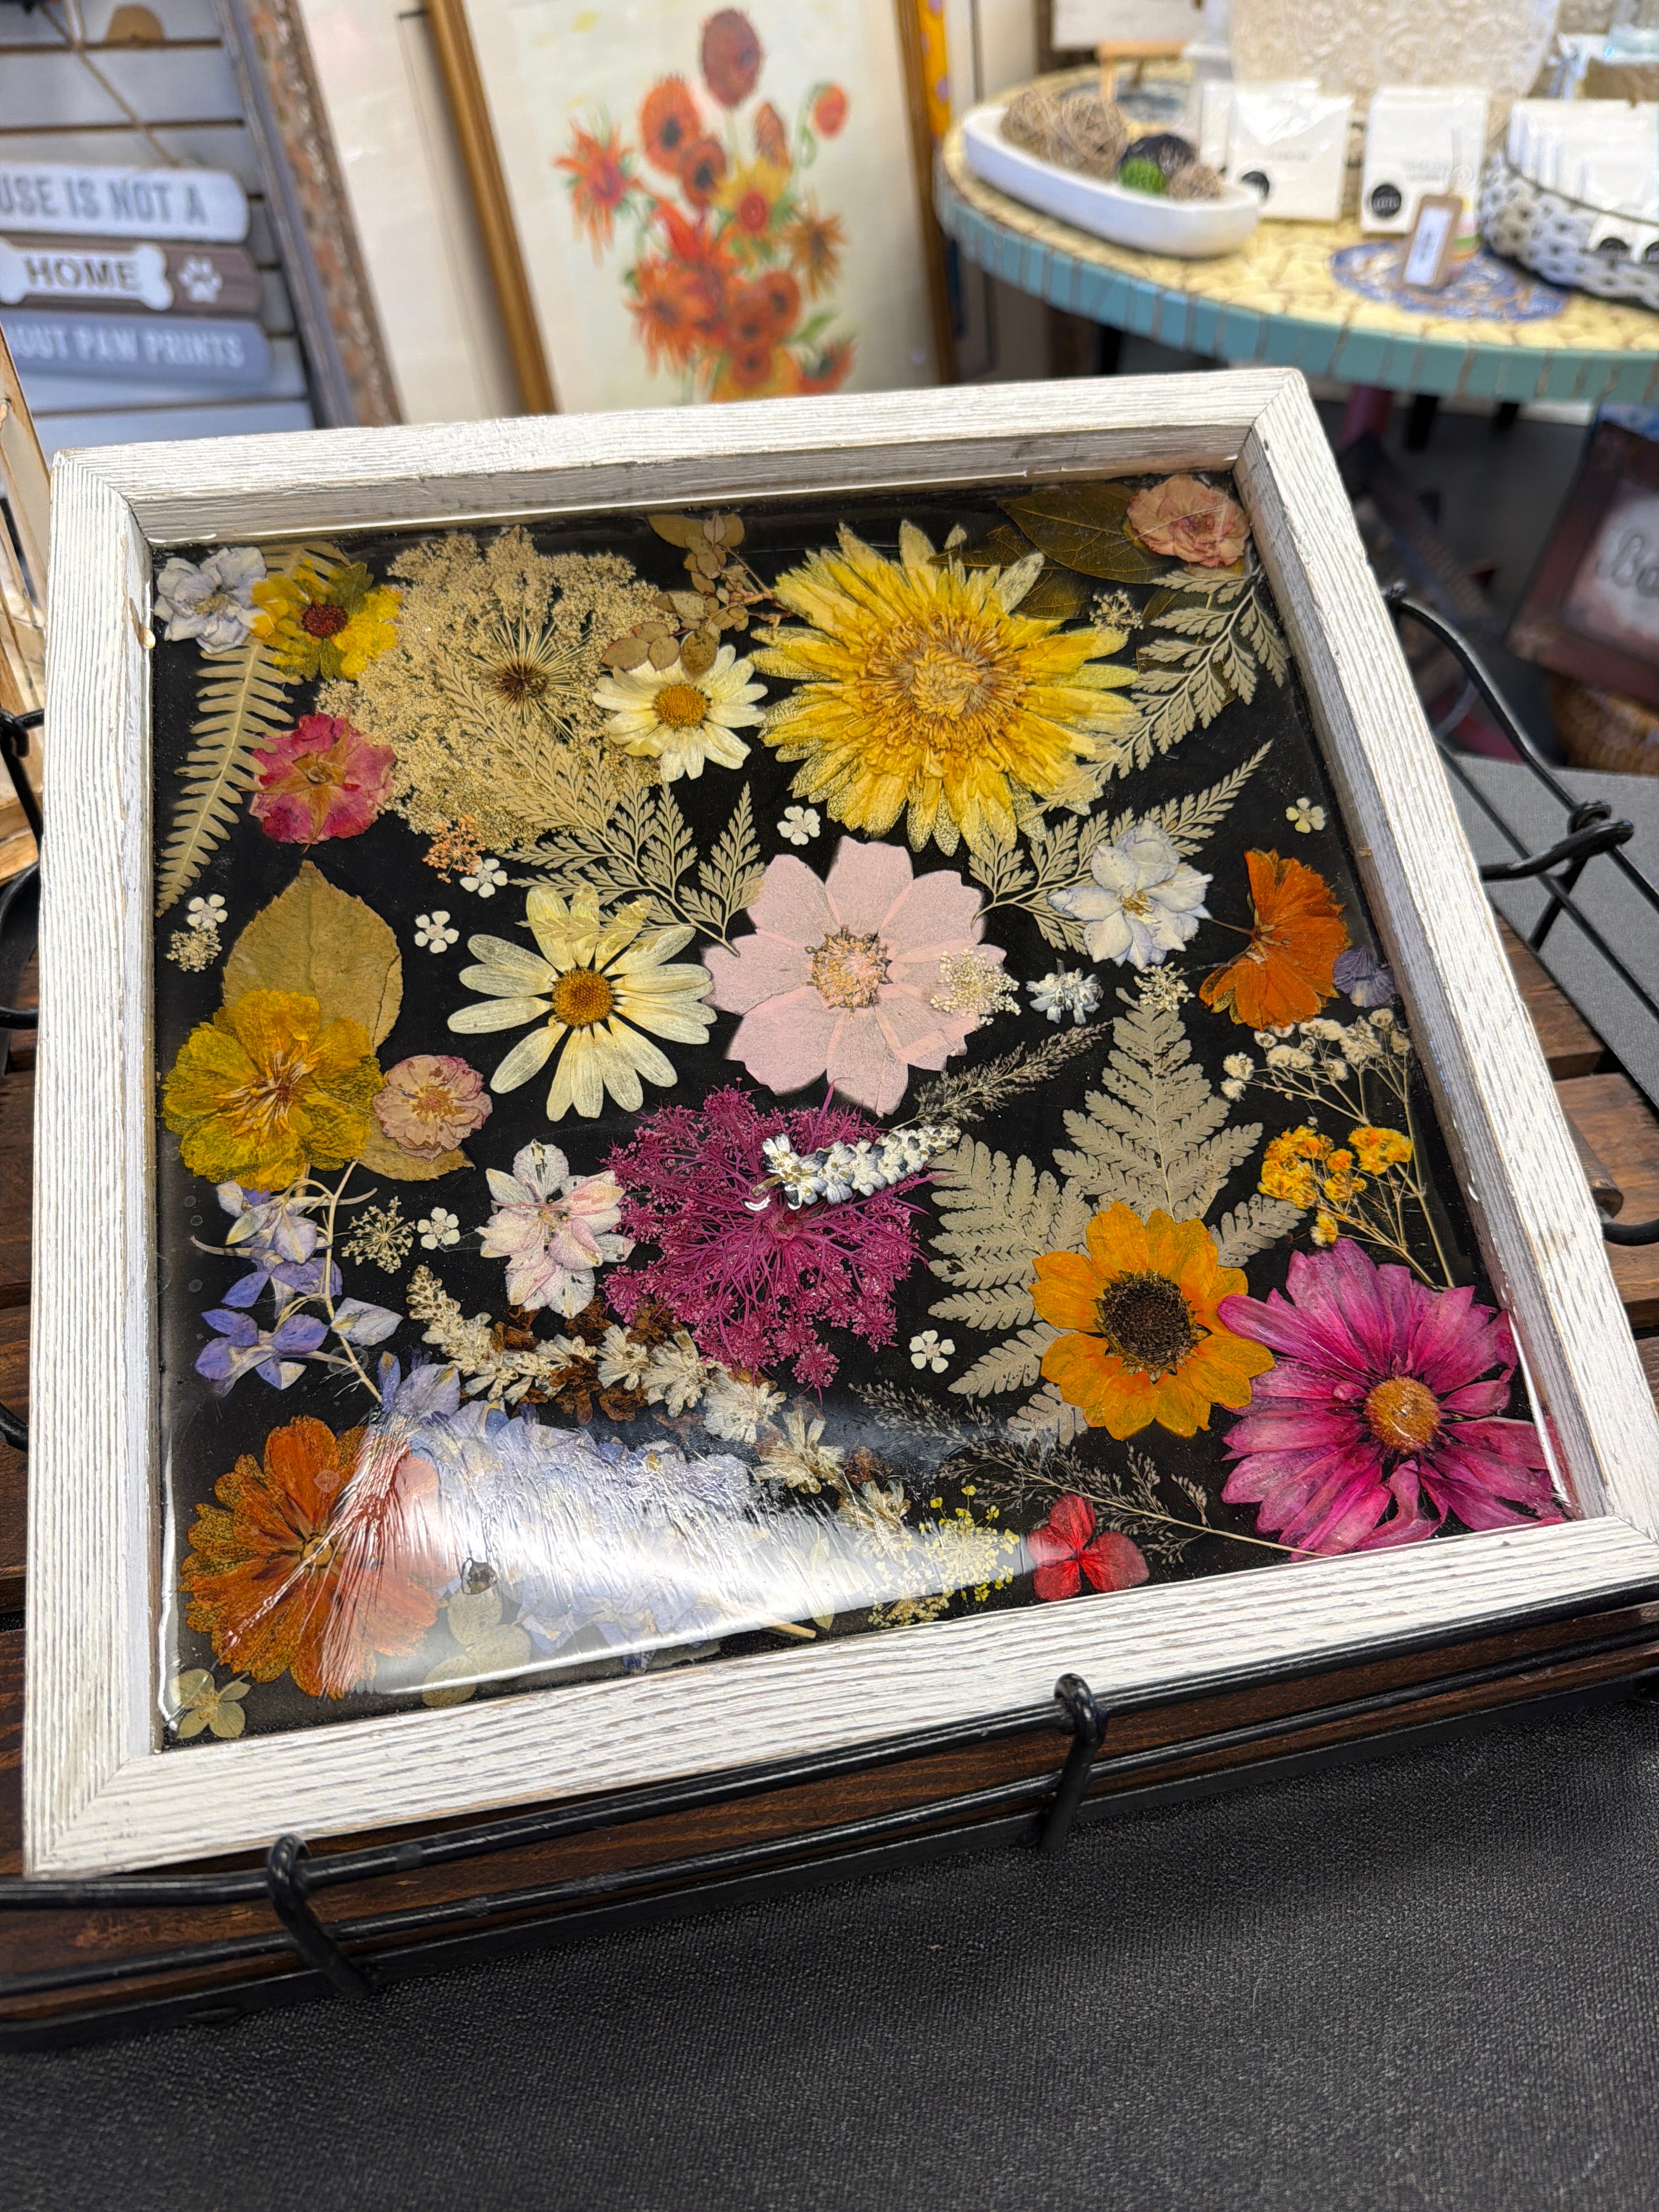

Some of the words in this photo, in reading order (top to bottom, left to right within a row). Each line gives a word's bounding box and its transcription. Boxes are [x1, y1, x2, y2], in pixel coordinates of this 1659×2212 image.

[64, 176, 99, 218] IS
[106, 178, 172, 222] NOT
[184, 183, 208, 225] A
[25, 256, 138, 291] HOME
[74, 326, 138, 364] PAW
[144, 329, 245, 368] PRINTS
